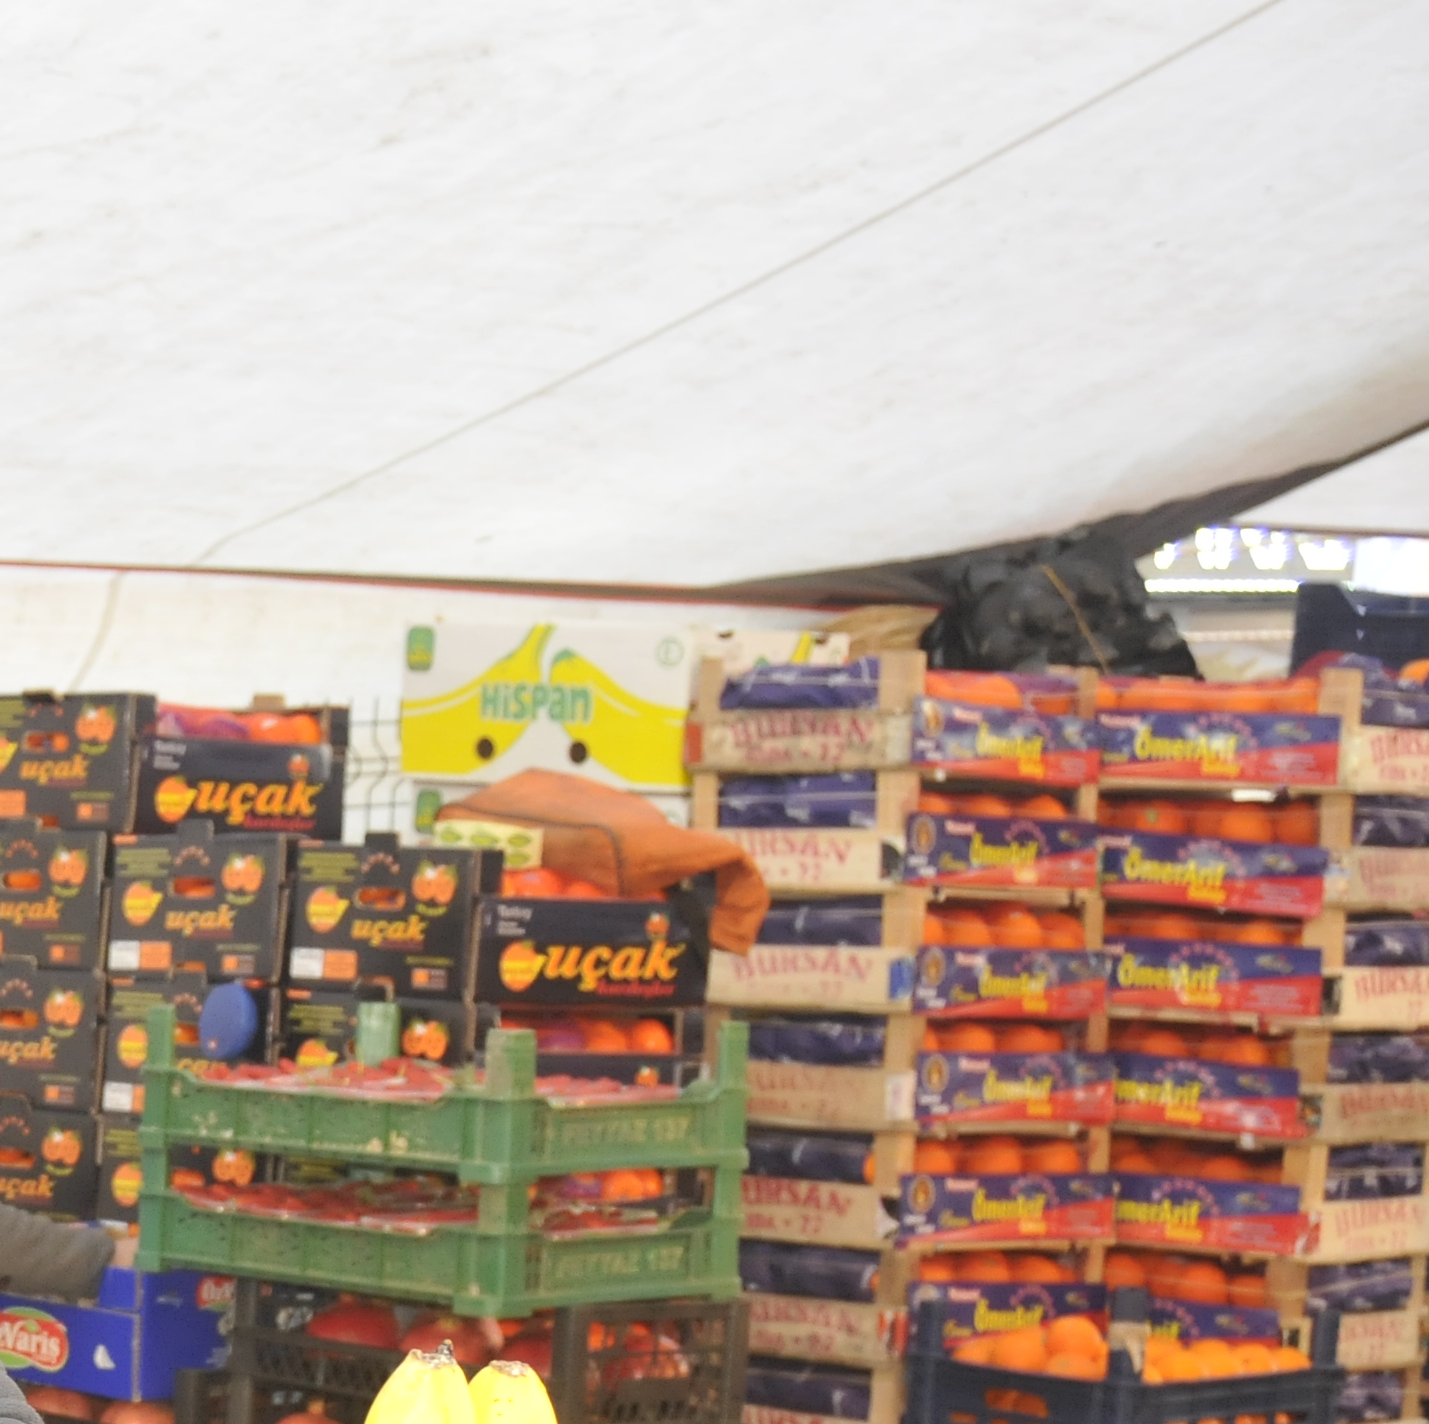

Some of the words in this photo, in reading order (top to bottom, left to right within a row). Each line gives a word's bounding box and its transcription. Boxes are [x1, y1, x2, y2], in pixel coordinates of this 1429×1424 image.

[20, 753, 90, 784] uçak
[194, 771, 323, 825] uçak
[166, 903, 237, 937] uçak
[350, 915, 428, 948] uçak
[543, 939, 686, 992] uçak
